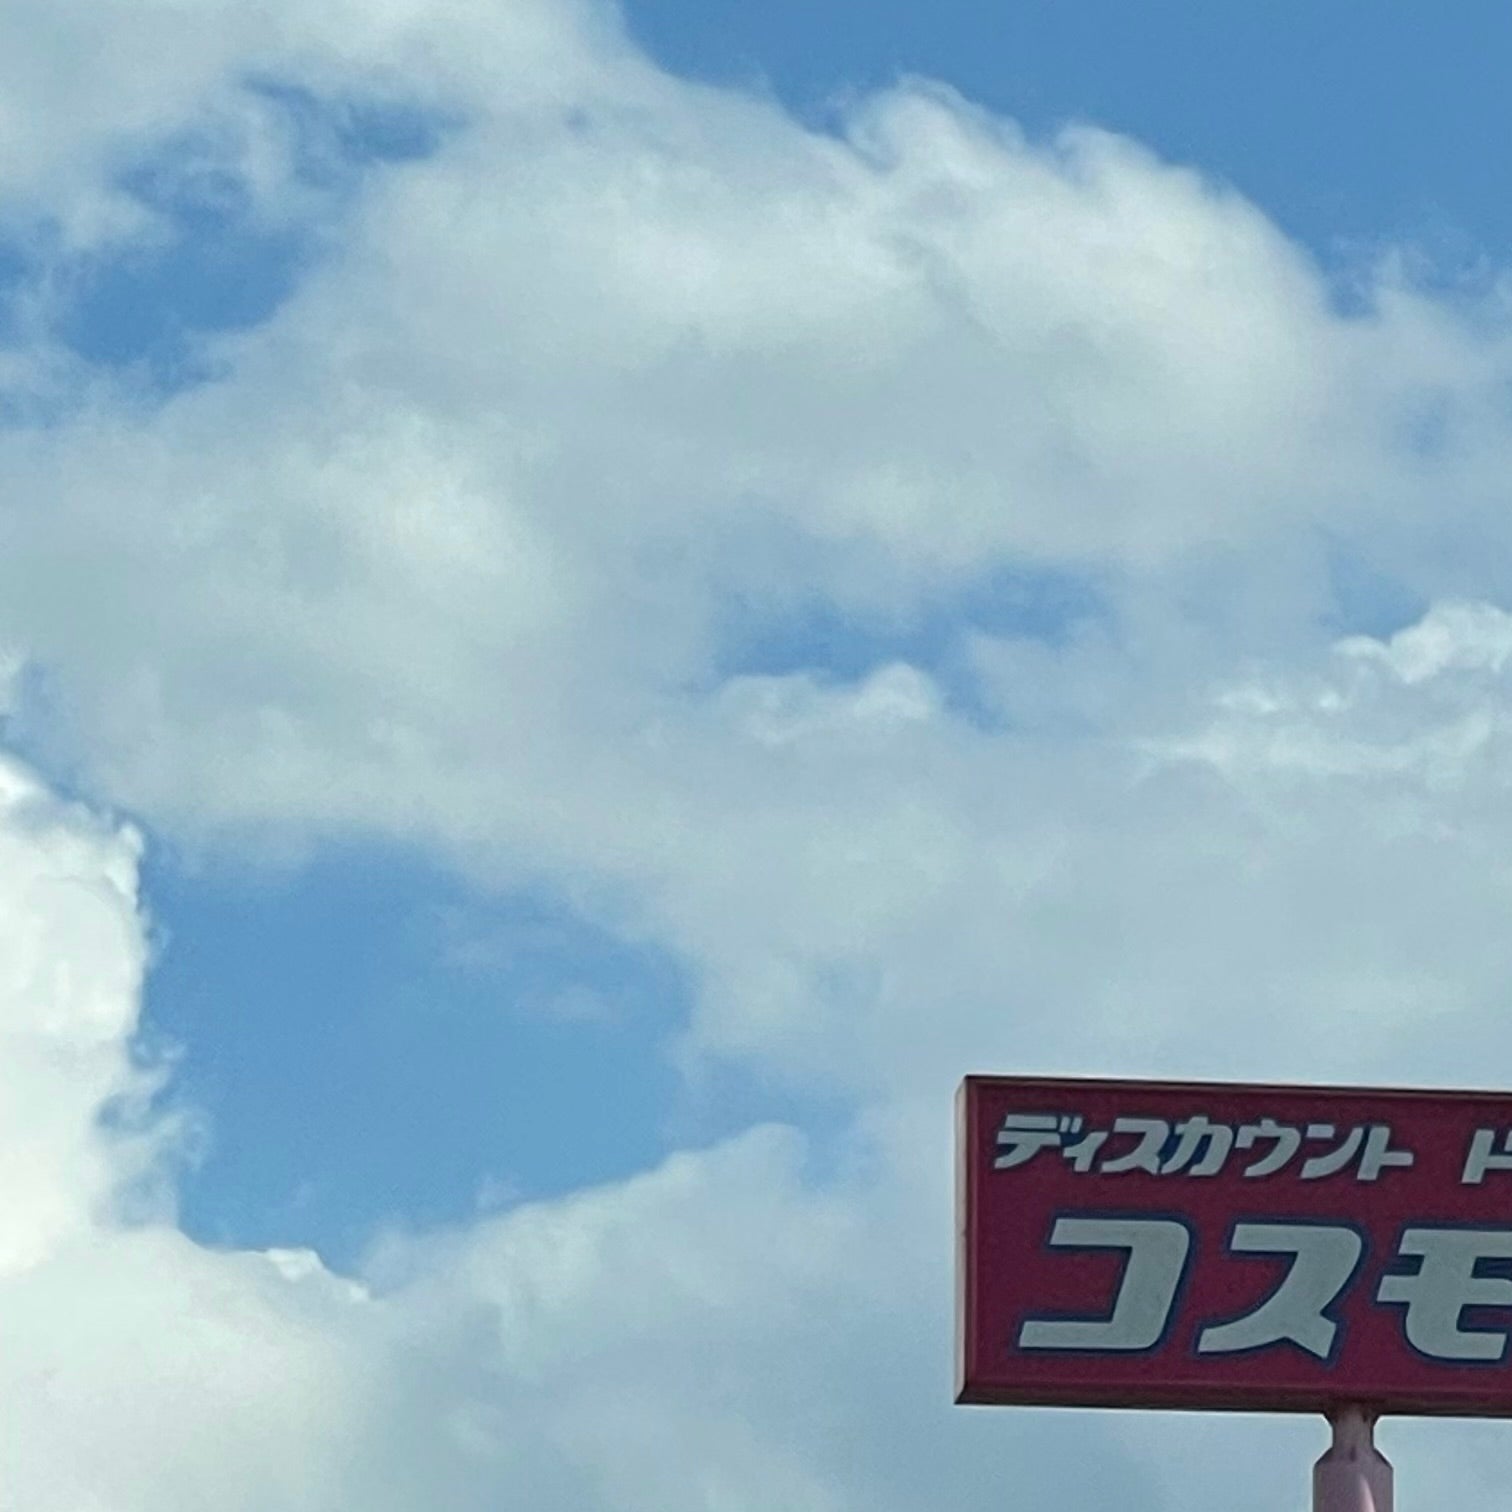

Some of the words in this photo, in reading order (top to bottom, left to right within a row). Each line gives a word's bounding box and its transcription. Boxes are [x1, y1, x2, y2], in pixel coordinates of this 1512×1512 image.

[994, 1113, 1414, 1182] ディスカウント
